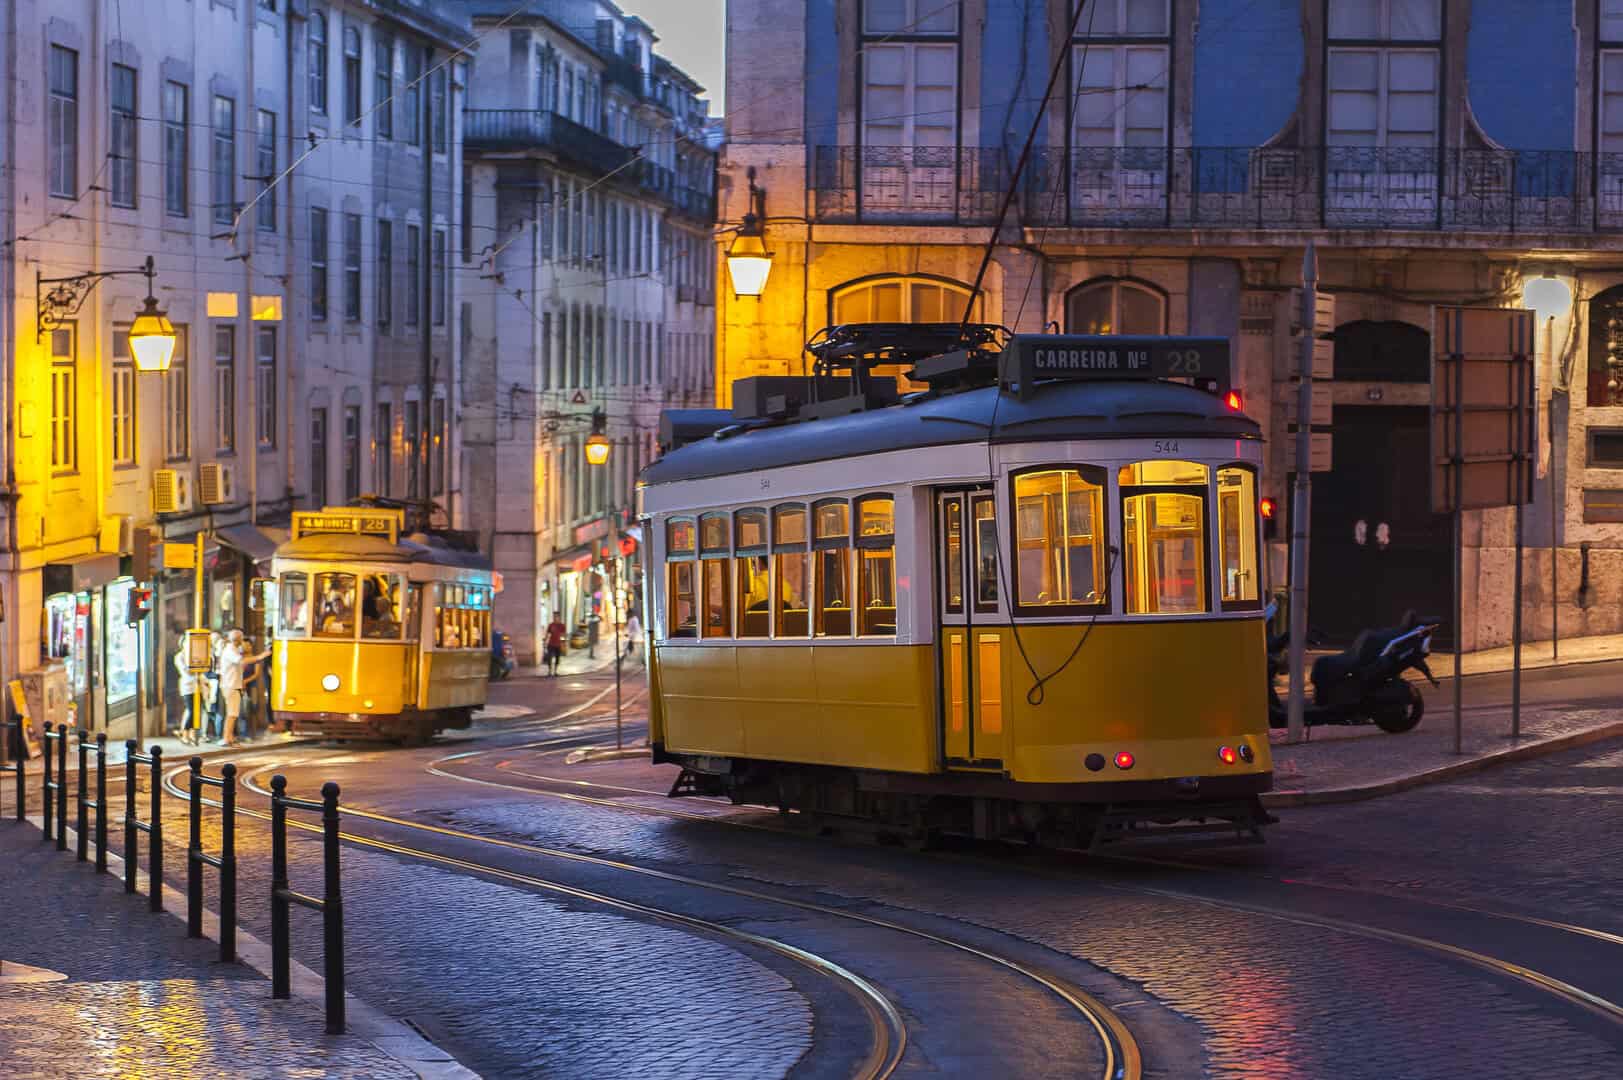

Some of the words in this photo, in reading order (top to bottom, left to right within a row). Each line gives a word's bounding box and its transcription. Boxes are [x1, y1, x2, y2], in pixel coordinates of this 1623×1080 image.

[1035, 349, 1118, 369] CARREIRA
[1167, 349, 1201, 373] 28
[1153, 440, 1178, 454] 544
[366, 519, 385, 530] 28
